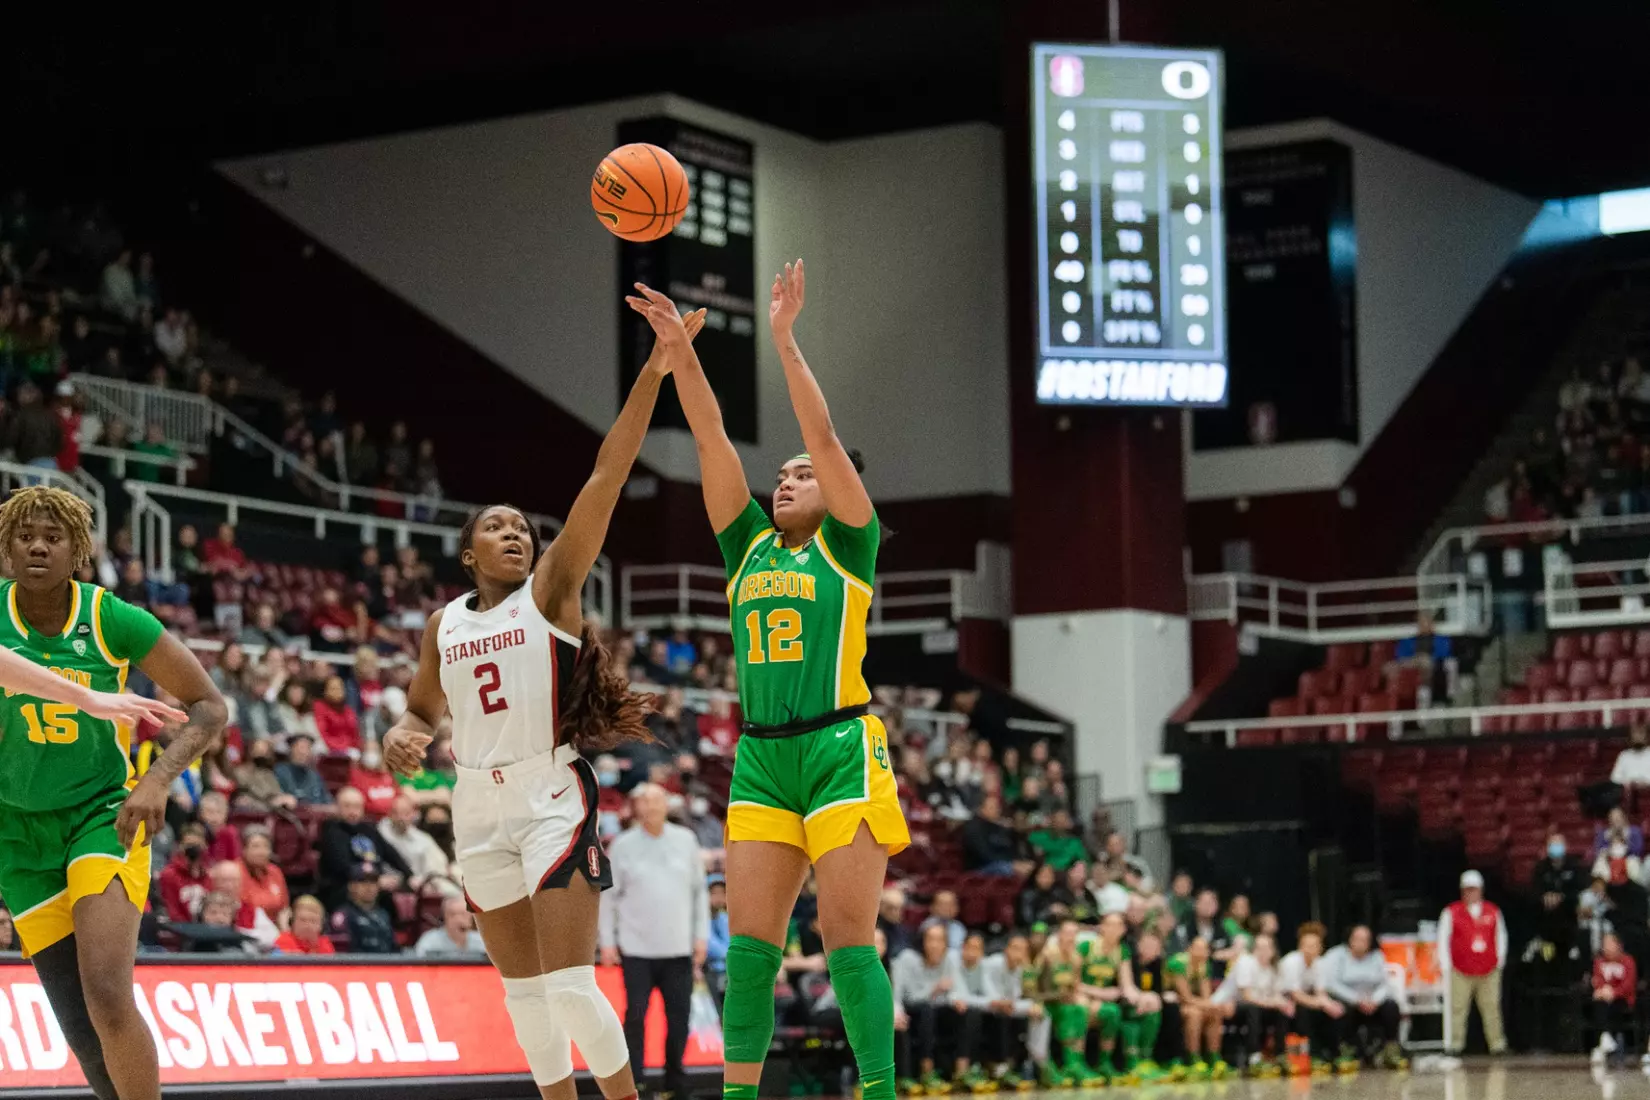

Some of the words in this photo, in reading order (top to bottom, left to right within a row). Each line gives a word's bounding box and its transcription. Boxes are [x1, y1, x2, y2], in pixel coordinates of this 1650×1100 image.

[737, 570, 816, 606] OREGON
[445, 628, 526, 665] STANFORD
[746, 608, 804, 664] 12
[473, 661, 509, 715] 2
[20, 703, 79, 744] 15
